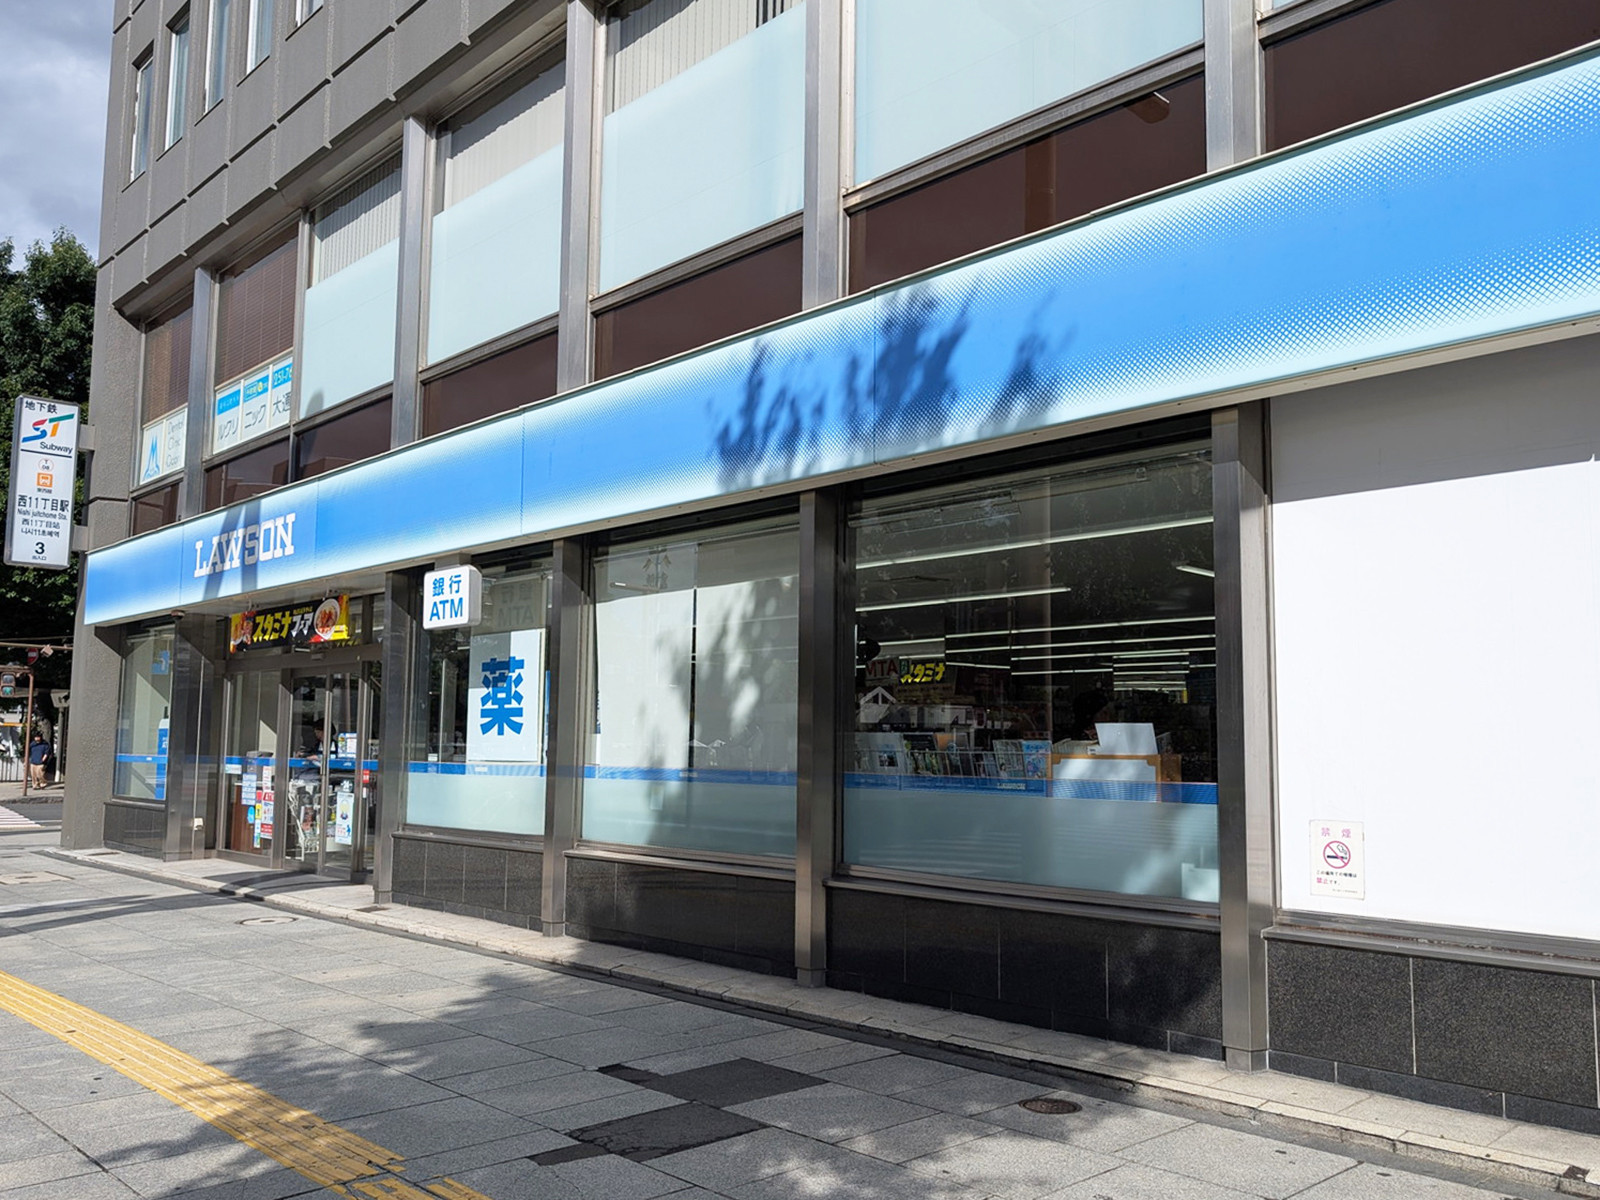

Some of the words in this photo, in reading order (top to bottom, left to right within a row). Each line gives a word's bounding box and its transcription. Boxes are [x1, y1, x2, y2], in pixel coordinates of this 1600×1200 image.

[25, 400, 58, 414] 地下鉄
[40, 441, 73, 455] Subway
[18, 494, 69, 512] 西11丁目駅
[35, 541, 45, 555] 3
[194, 512, 296, 578] LAWSON
[432, 574, 462, 597] 銀行
[429, 597, 463, 621] ATM
[480, 656, 525, 735] 薬
